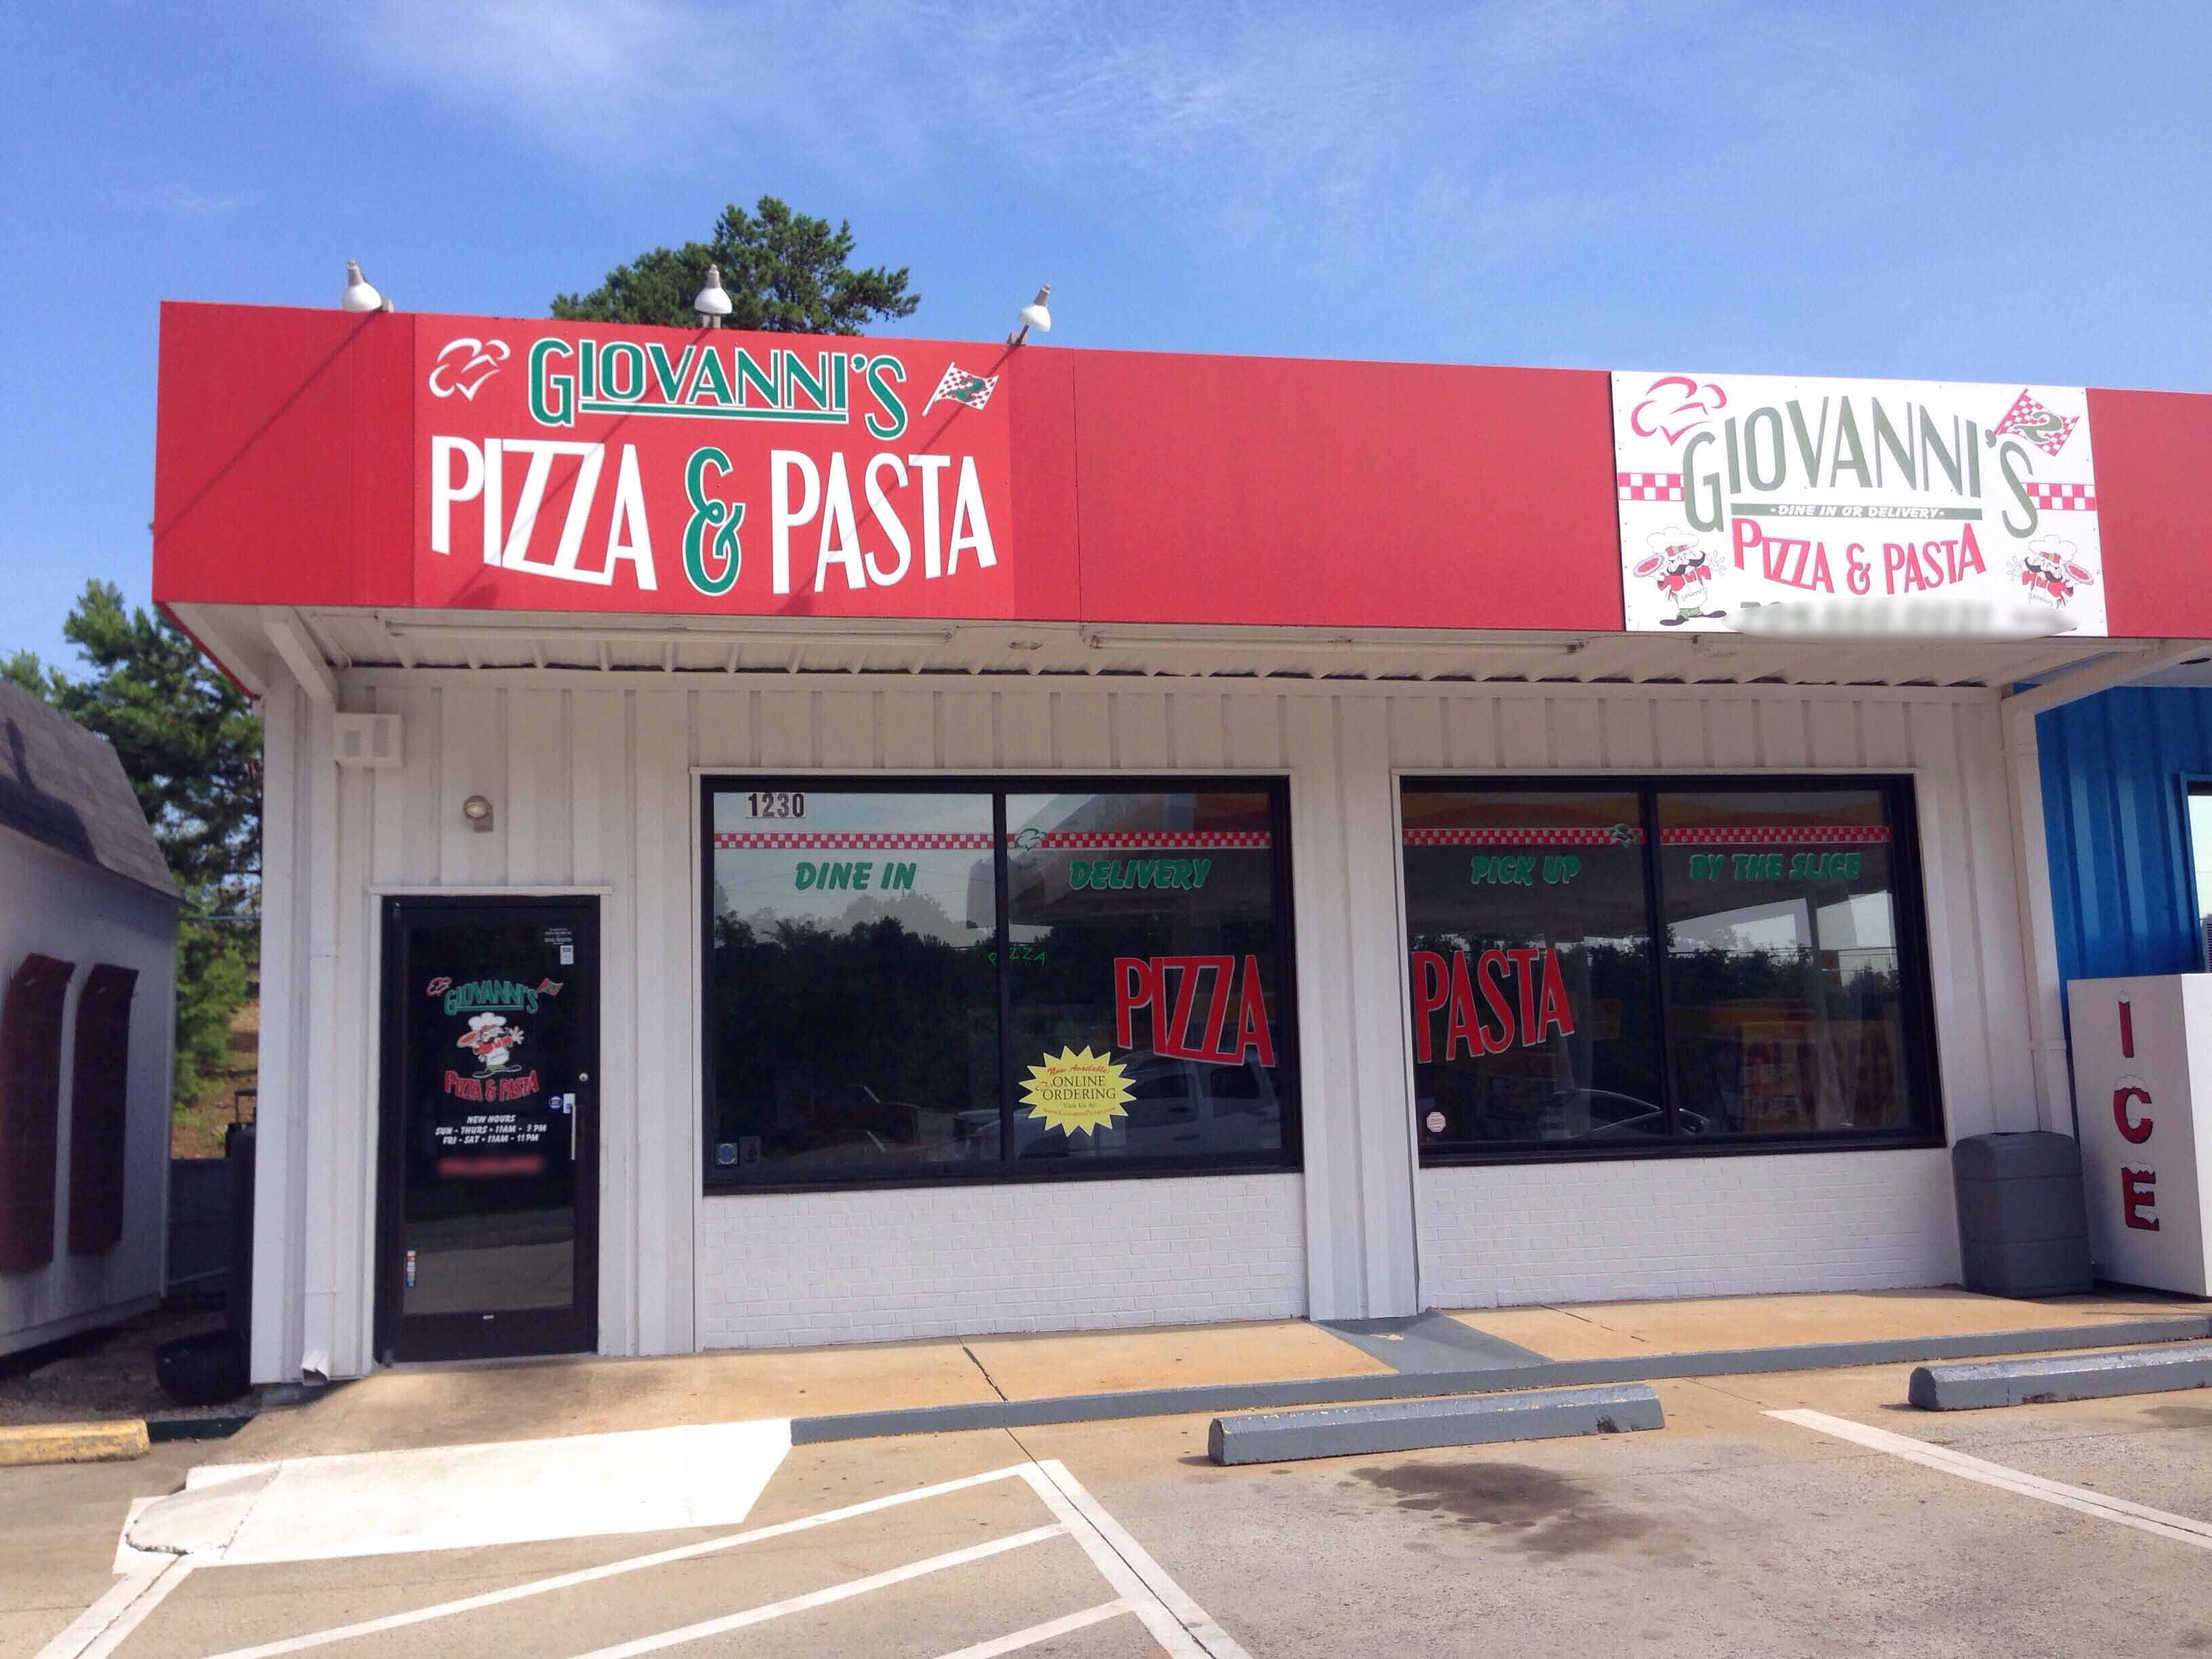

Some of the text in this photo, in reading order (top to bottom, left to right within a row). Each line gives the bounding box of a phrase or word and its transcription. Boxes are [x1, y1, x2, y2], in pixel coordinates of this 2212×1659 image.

[527, 337, 907, 441] GIOVANNI'S
[1683, 395, 2039, 538] GIOVANNI'S
[431, 435, 998, 596] PIZZA & PASTA
[1778, 505, 1938, 518] DINE IN OR DELIVERY
[1732, 518, 1986, 595] PIZZA & PASTA
[748, 793, 804, 818] 1230
[794, 861, 917, 890] DINE IN
[1068, 858, 1212, 890] DELIVERY
[1471, 855, 1582, 886] PICK UP
[1689, 853, 1860, 880] BY THE SLICE
[987, 942, 1046, 966] PZZA
[444, 979, 539, 1015] GIOVANNI'S
[1113, 954, 1276, 1067] PIZZA
[1412, 947, 1575, 1065] PASTA
[445, 1069, 539, 1102] PIZZA & PASTA
[1042, 1088, 1115, 1101] ORDERING
[1052, 1075, 1106, 1088] ONLINE
[467, 1114, 516, 1124] NEW HOURS
[2112, 990, 2160, 1232] ICE
[435, 1127, 453, 1135] SUN
[461, 1126, 488, 1134] THURS
[495, 1125, 516, 1134] 11AM
[533, 1124, 547, 1132] PM
[443, 1136, 457, 1145] FRI
[464, 1135, 480, 1144] SAT
[487, 1134, 508, 1143] 11AM
